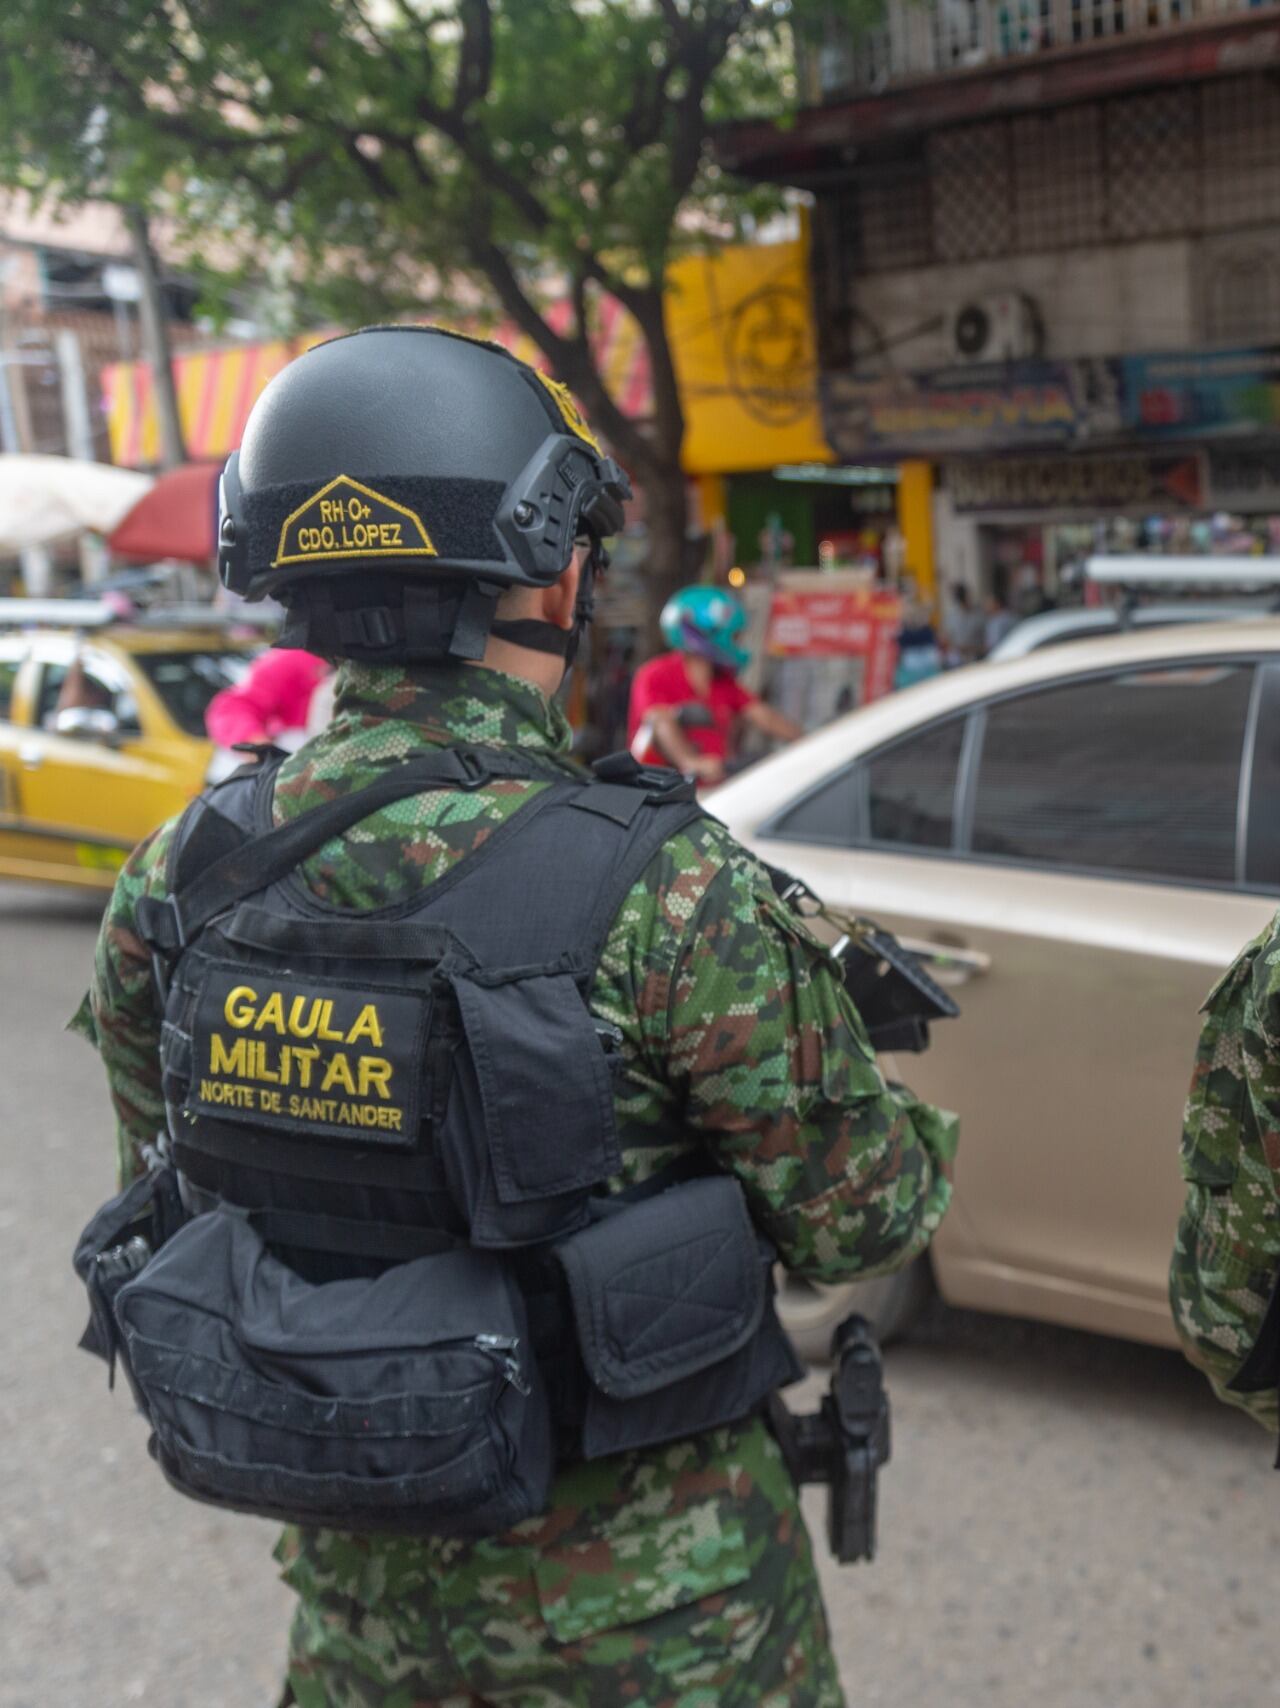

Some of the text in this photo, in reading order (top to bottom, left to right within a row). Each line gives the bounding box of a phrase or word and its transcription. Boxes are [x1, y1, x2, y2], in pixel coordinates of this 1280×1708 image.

[298, 523, 402, 551] CDO. LOPEZ
[320, 499, 345, 523] RH
[224, 985, 383, 1048] GAULA
[209, 1033, 393, 1099] MILITAR
[199, 1079, 403, 1131] NORTE DE SANTANDER
